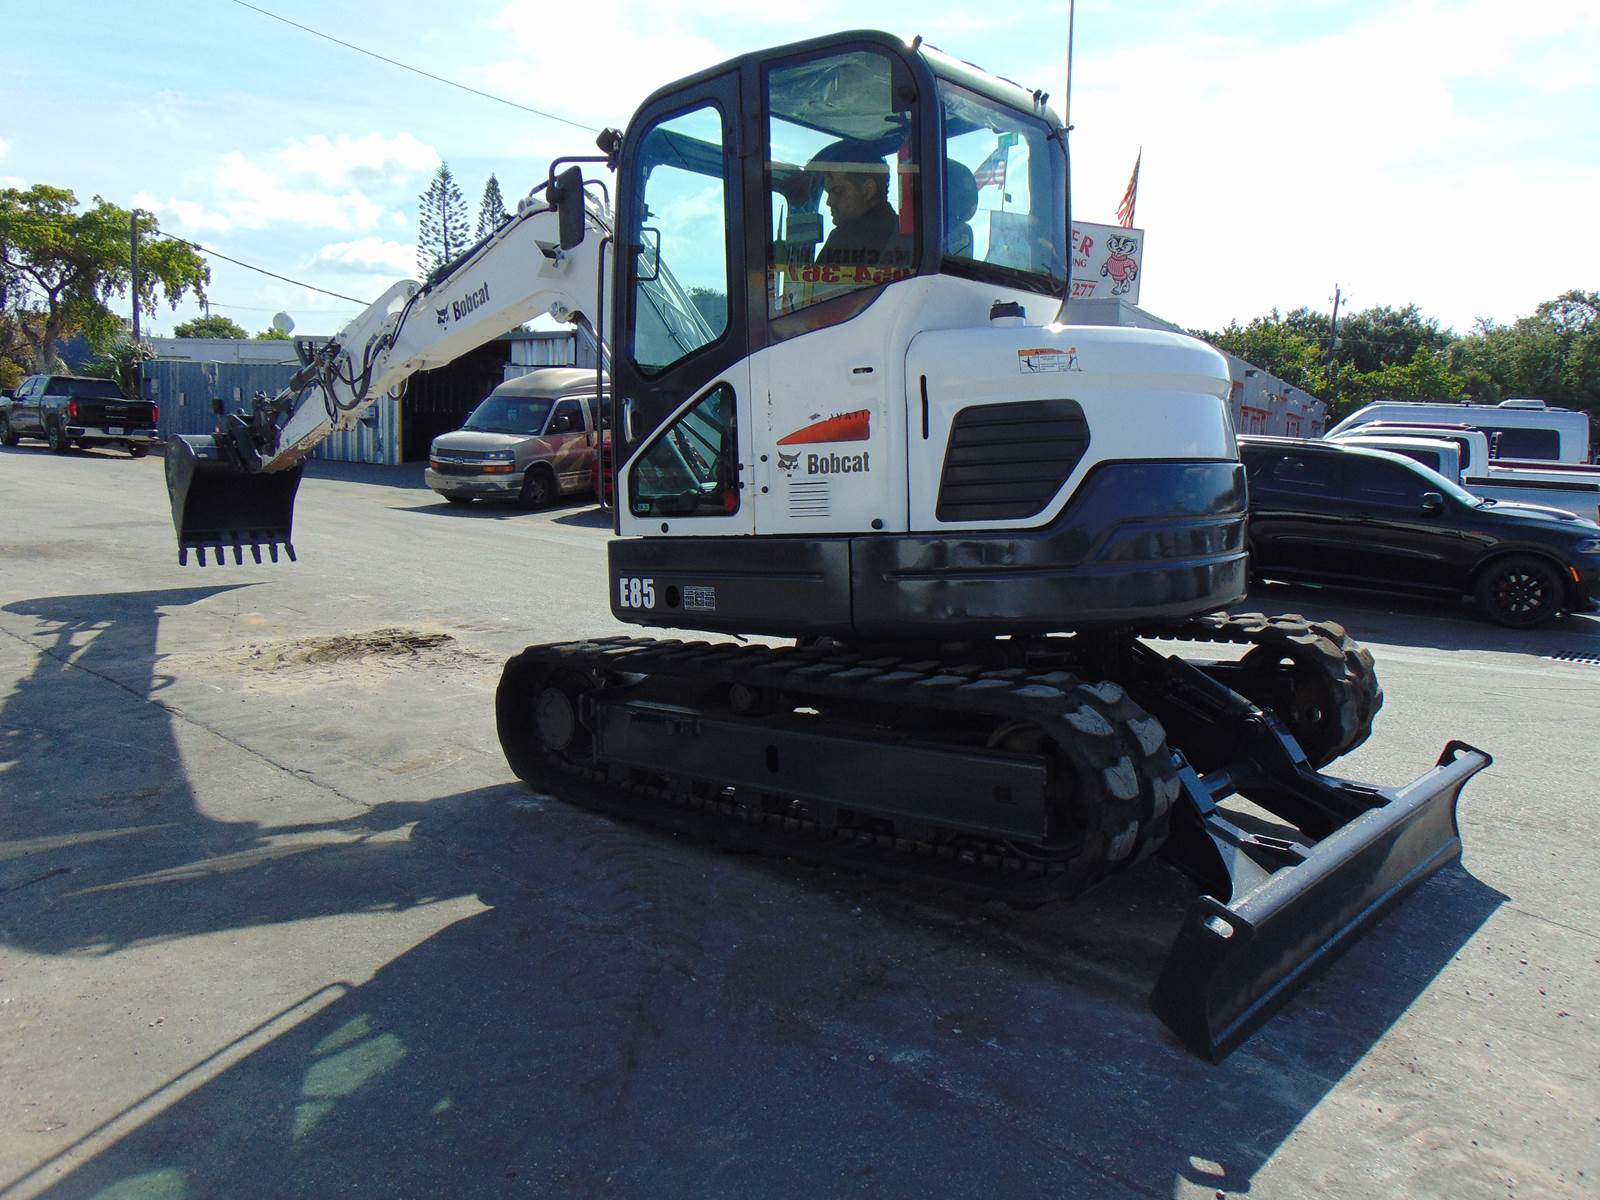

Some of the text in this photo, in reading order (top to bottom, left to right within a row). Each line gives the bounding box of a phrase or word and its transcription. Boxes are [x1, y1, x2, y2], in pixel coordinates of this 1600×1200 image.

[453, 281, 490, 321] Bobcat
[808, 451, 870, 475] Bobcat
[619, 578, 655, 609] E85
